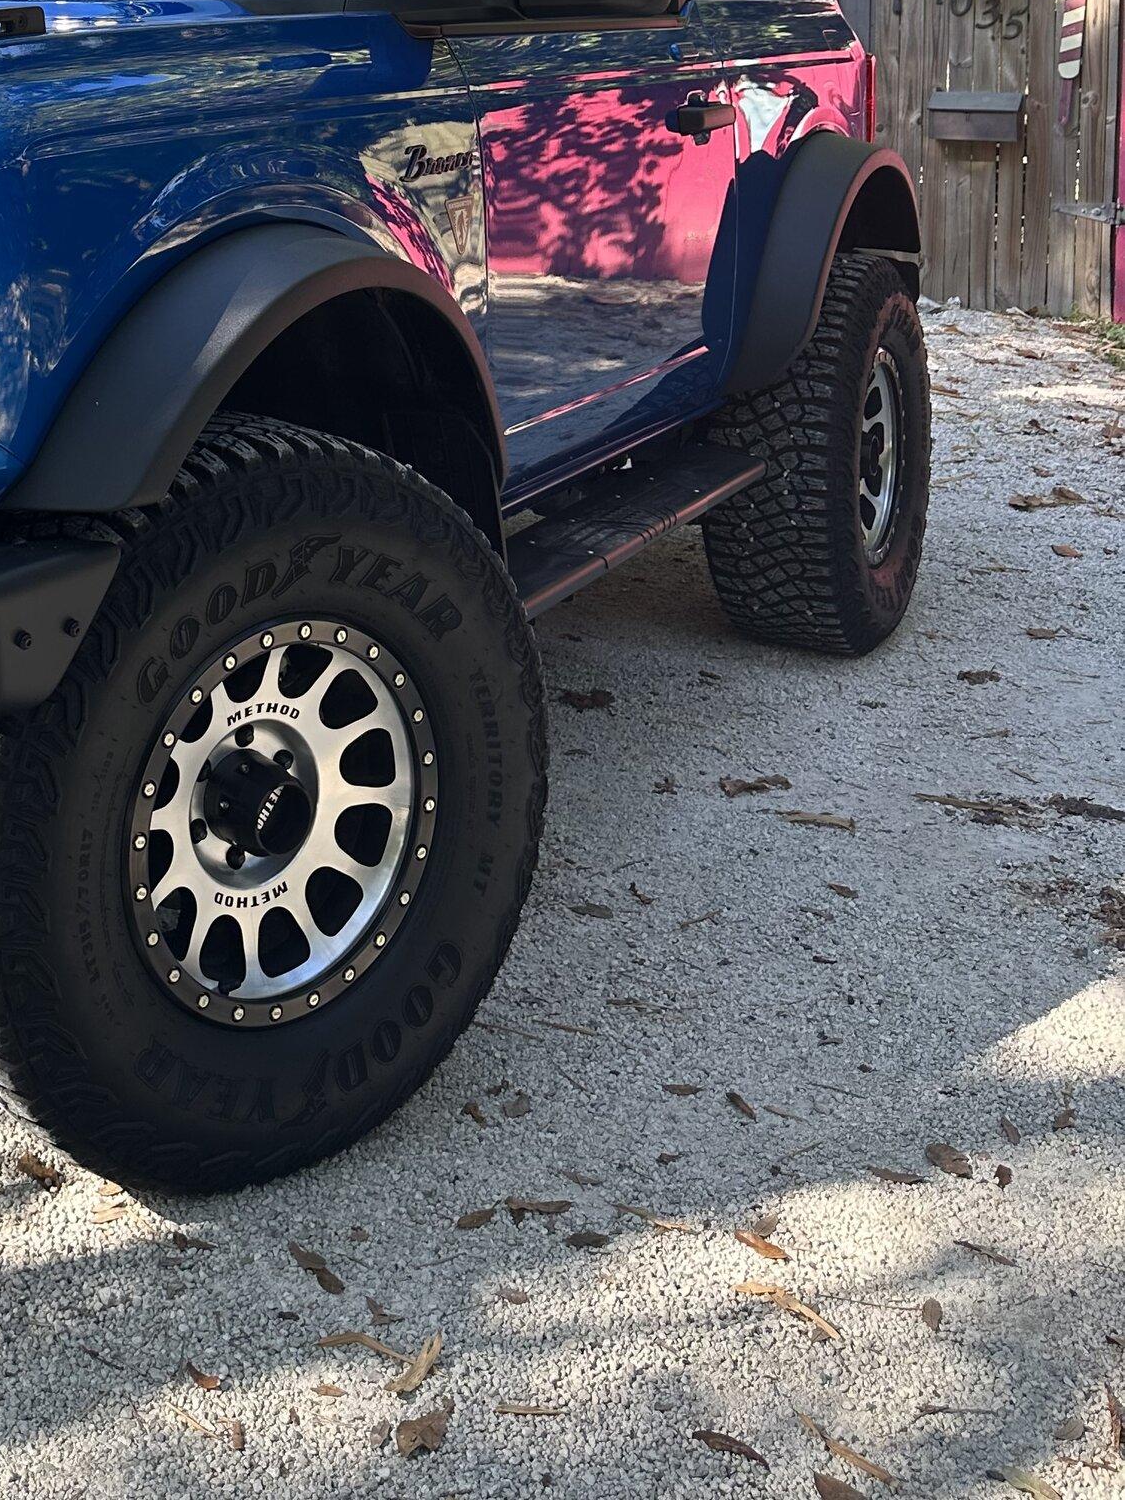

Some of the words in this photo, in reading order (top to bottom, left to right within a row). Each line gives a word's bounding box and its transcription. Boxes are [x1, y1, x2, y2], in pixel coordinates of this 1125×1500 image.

[137, 533, 463, 704] GOODYEAR
[226, 703, 300, 727] METHOD
[214, 881, 288, 908] METHOD
